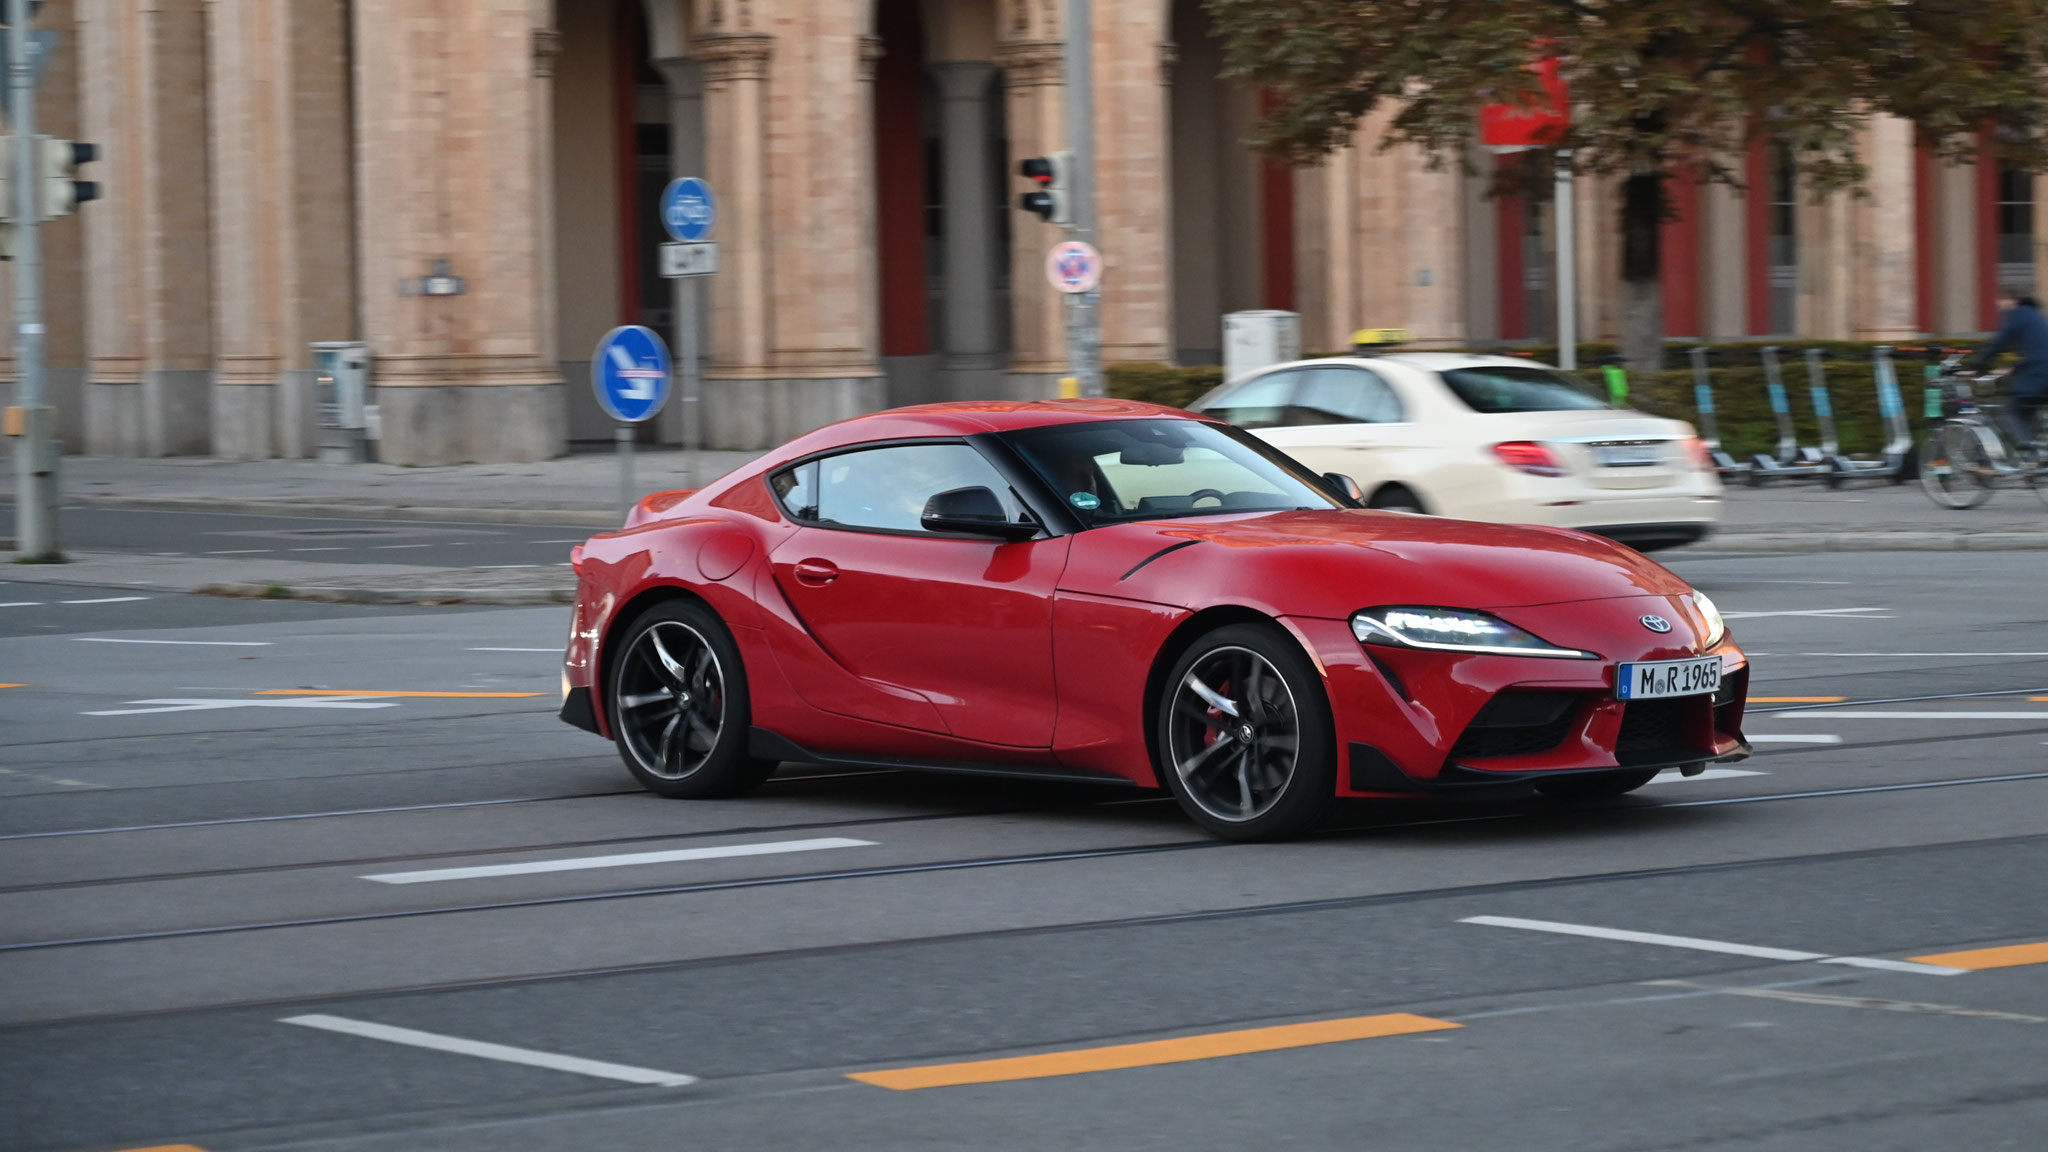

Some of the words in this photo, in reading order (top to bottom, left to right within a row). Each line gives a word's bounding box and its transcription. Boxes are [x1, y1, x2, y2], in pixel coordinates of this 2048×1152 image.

[1641, 668, 1655, 694] M
[1667, 666, 1678, 692] R
[1682, 662, 1717, 691] 1965
[1622, 685, 1628, 694] D
